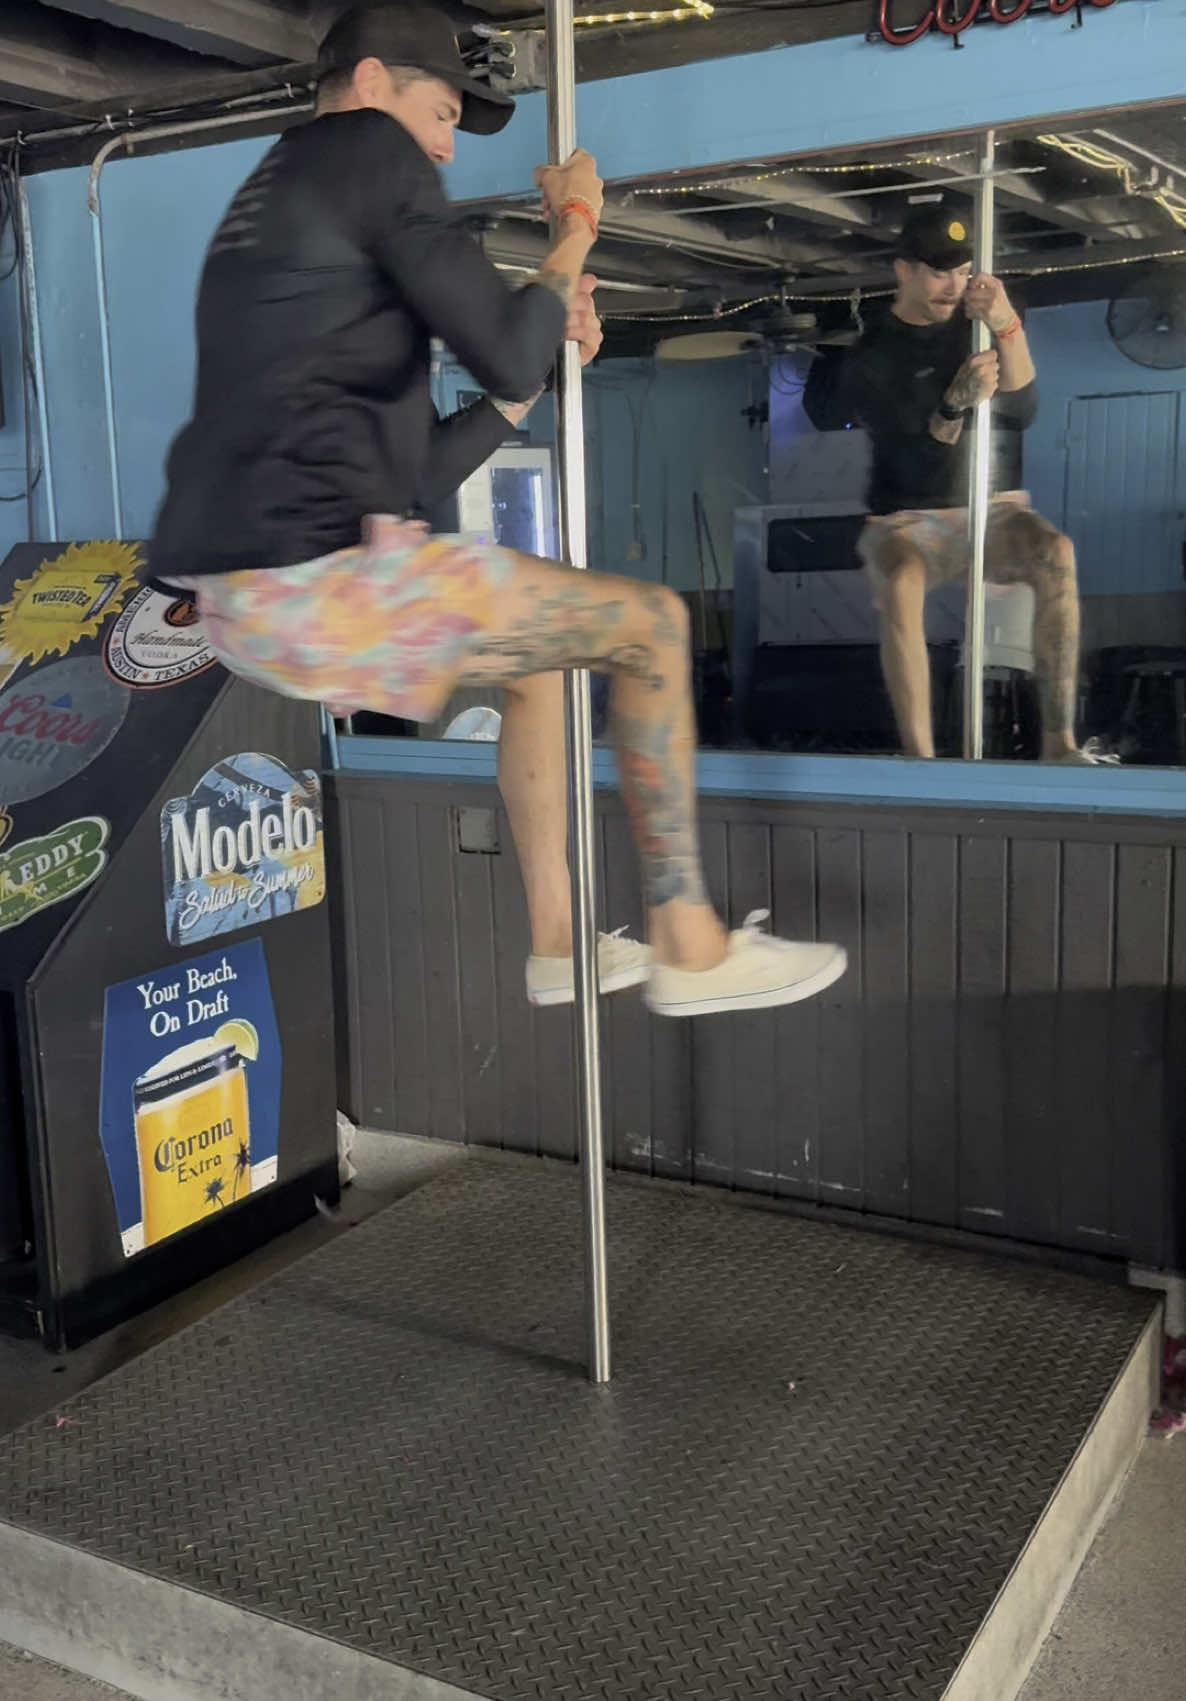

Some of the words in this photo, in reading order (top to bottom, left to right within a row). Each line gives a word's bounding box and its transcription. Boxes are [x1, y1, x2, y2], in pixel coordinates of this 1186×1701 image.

[32, 589, 76, 604] TWISTED
[111, 647, 142, 680] AUSTIN
[155, 653, 209, 680] TEXAS
[0, 695, 102, 745] Coors
[218, 783, 272, 808] CERVEZA
[171, 791, 317, 883] Modelo
[179, 879, 237, 930] Salud
[248, 863, 314, 908] Summer
[136, 981, 181, 1010] Your
[186, 956, 238, 994] Beach,
[150, 1011, 181, 1037] On
[186, 989, 230, 1026] Draft
[154, 1117, 233, 1173] Corona
[177, 1154, 222, 1184] Extra
